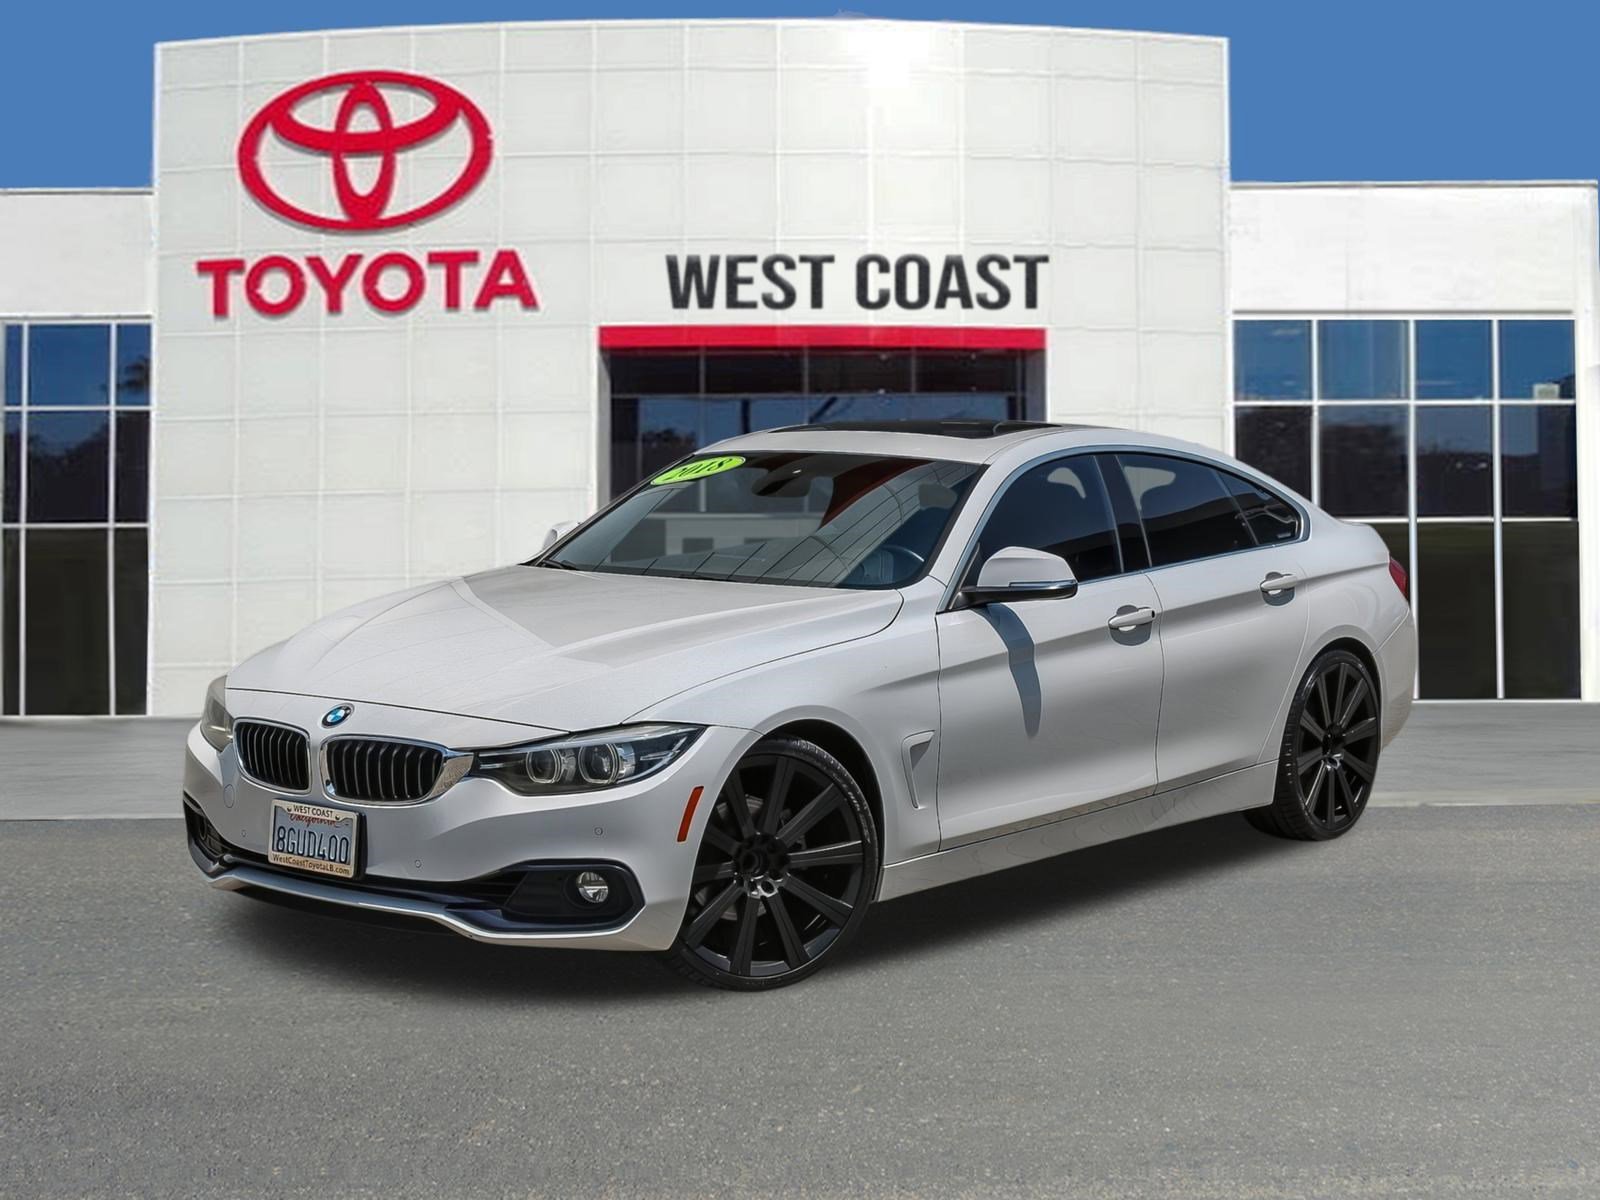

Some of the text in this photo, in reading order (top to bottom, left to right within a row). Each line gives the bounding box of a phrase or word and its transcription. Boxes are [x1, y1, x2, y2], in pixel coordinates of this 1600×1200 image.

[195, 250, 539, 317] TOYOTA
[666, 254, 1050, 310] WEST COAST
[661, 457, 733, 481] 2018
[293, 804, 334, 818] WEST COAST
[275, 825, 350, 864] 8GUD400
[272, 853, 350, 876] WestCoastToyotaLB.com
